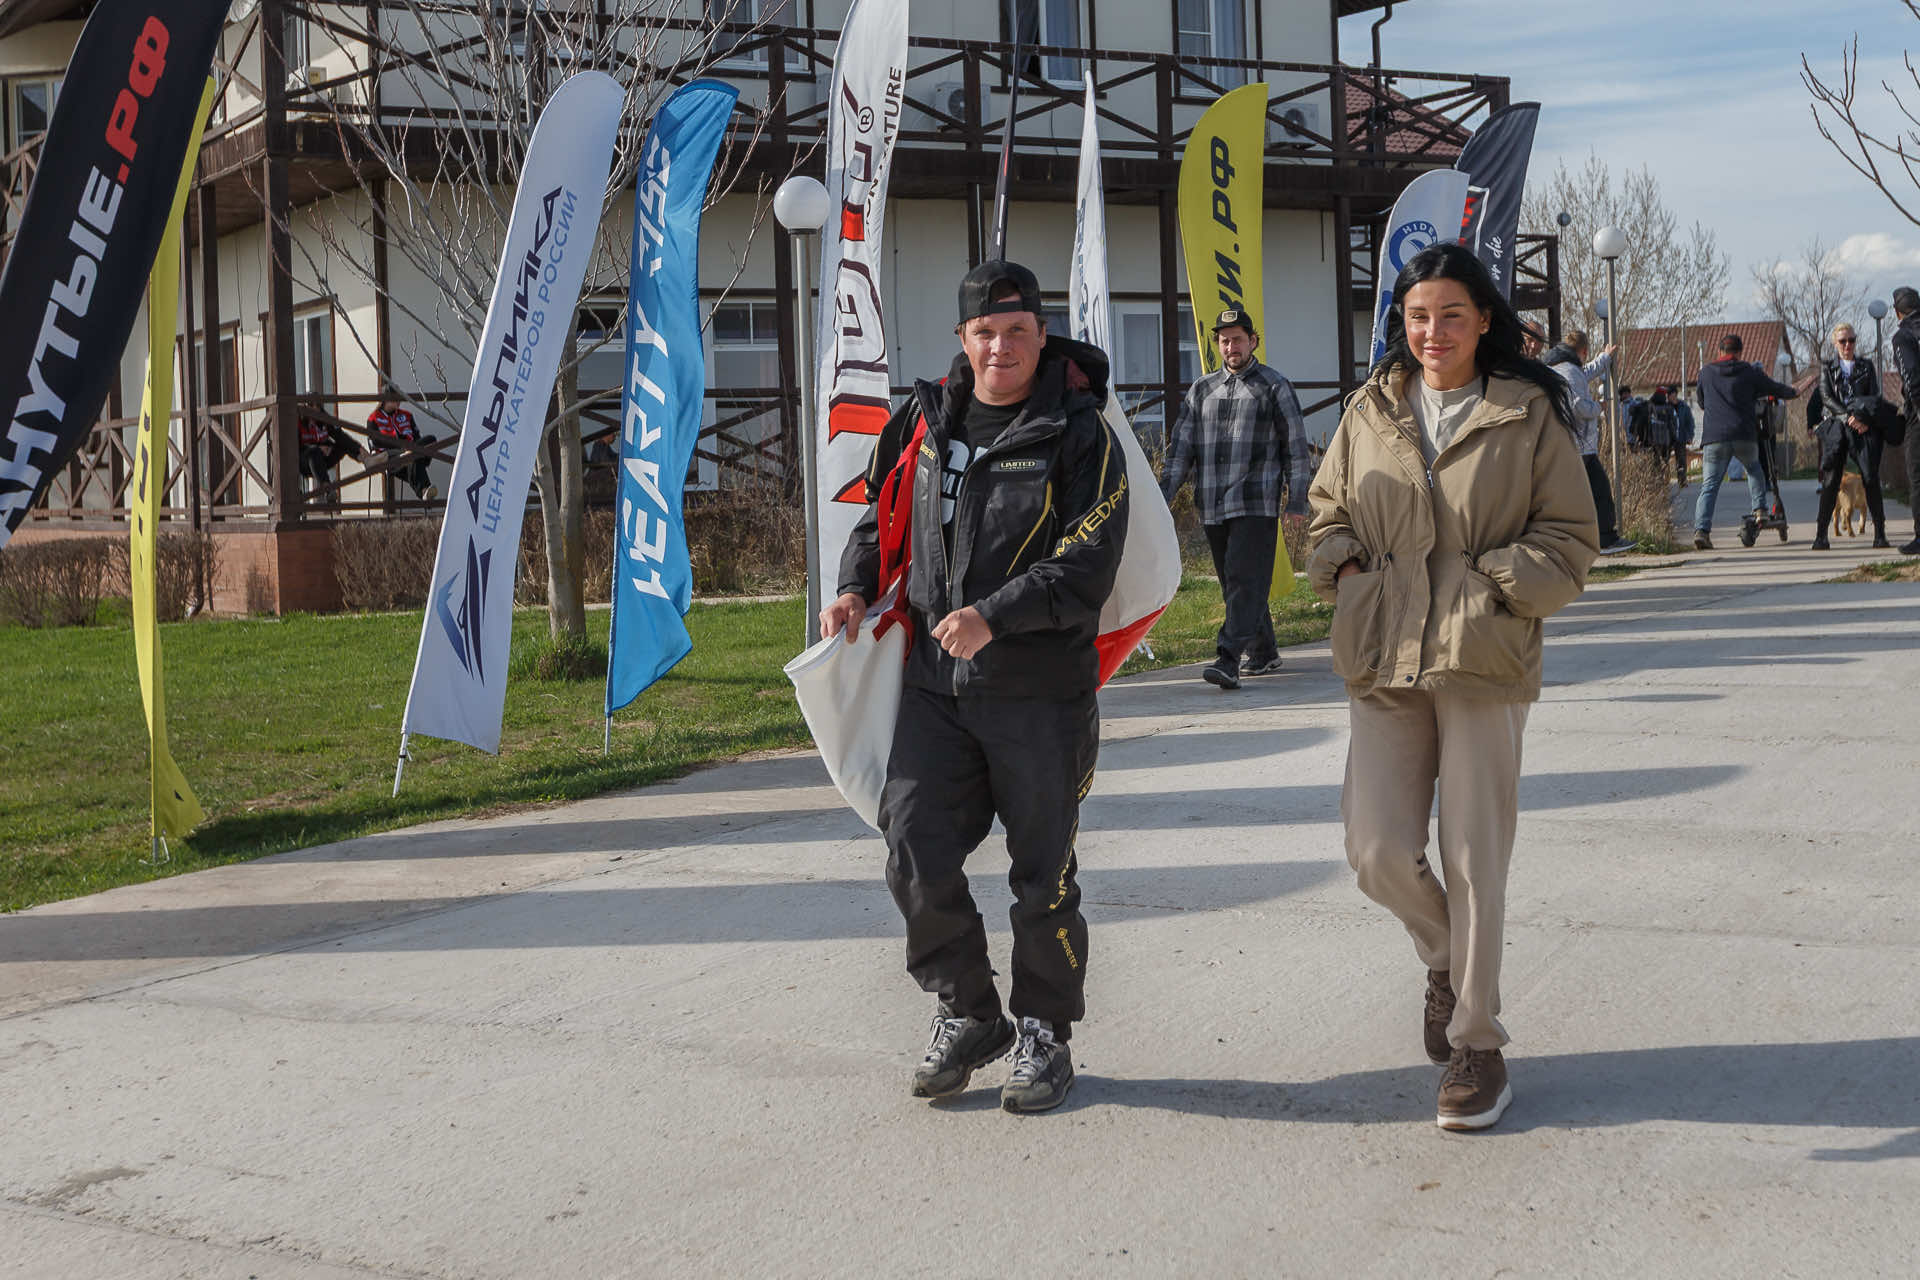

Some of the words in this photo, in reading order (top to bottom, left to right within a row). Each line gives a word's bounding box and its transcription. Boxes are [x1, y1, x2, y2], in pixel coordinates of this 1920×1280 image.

[465, 186, 563, 524] АЛЬПИЙКА
[481, 439, 512, 533] ЦЕНТР
[504, 309, 545, 435] КАТЕРОВ
[536, 190, 579, 304] РОССИИ
[1485, 236, 1503, 258] die
[623, 302, 671, 600] HEARTY
